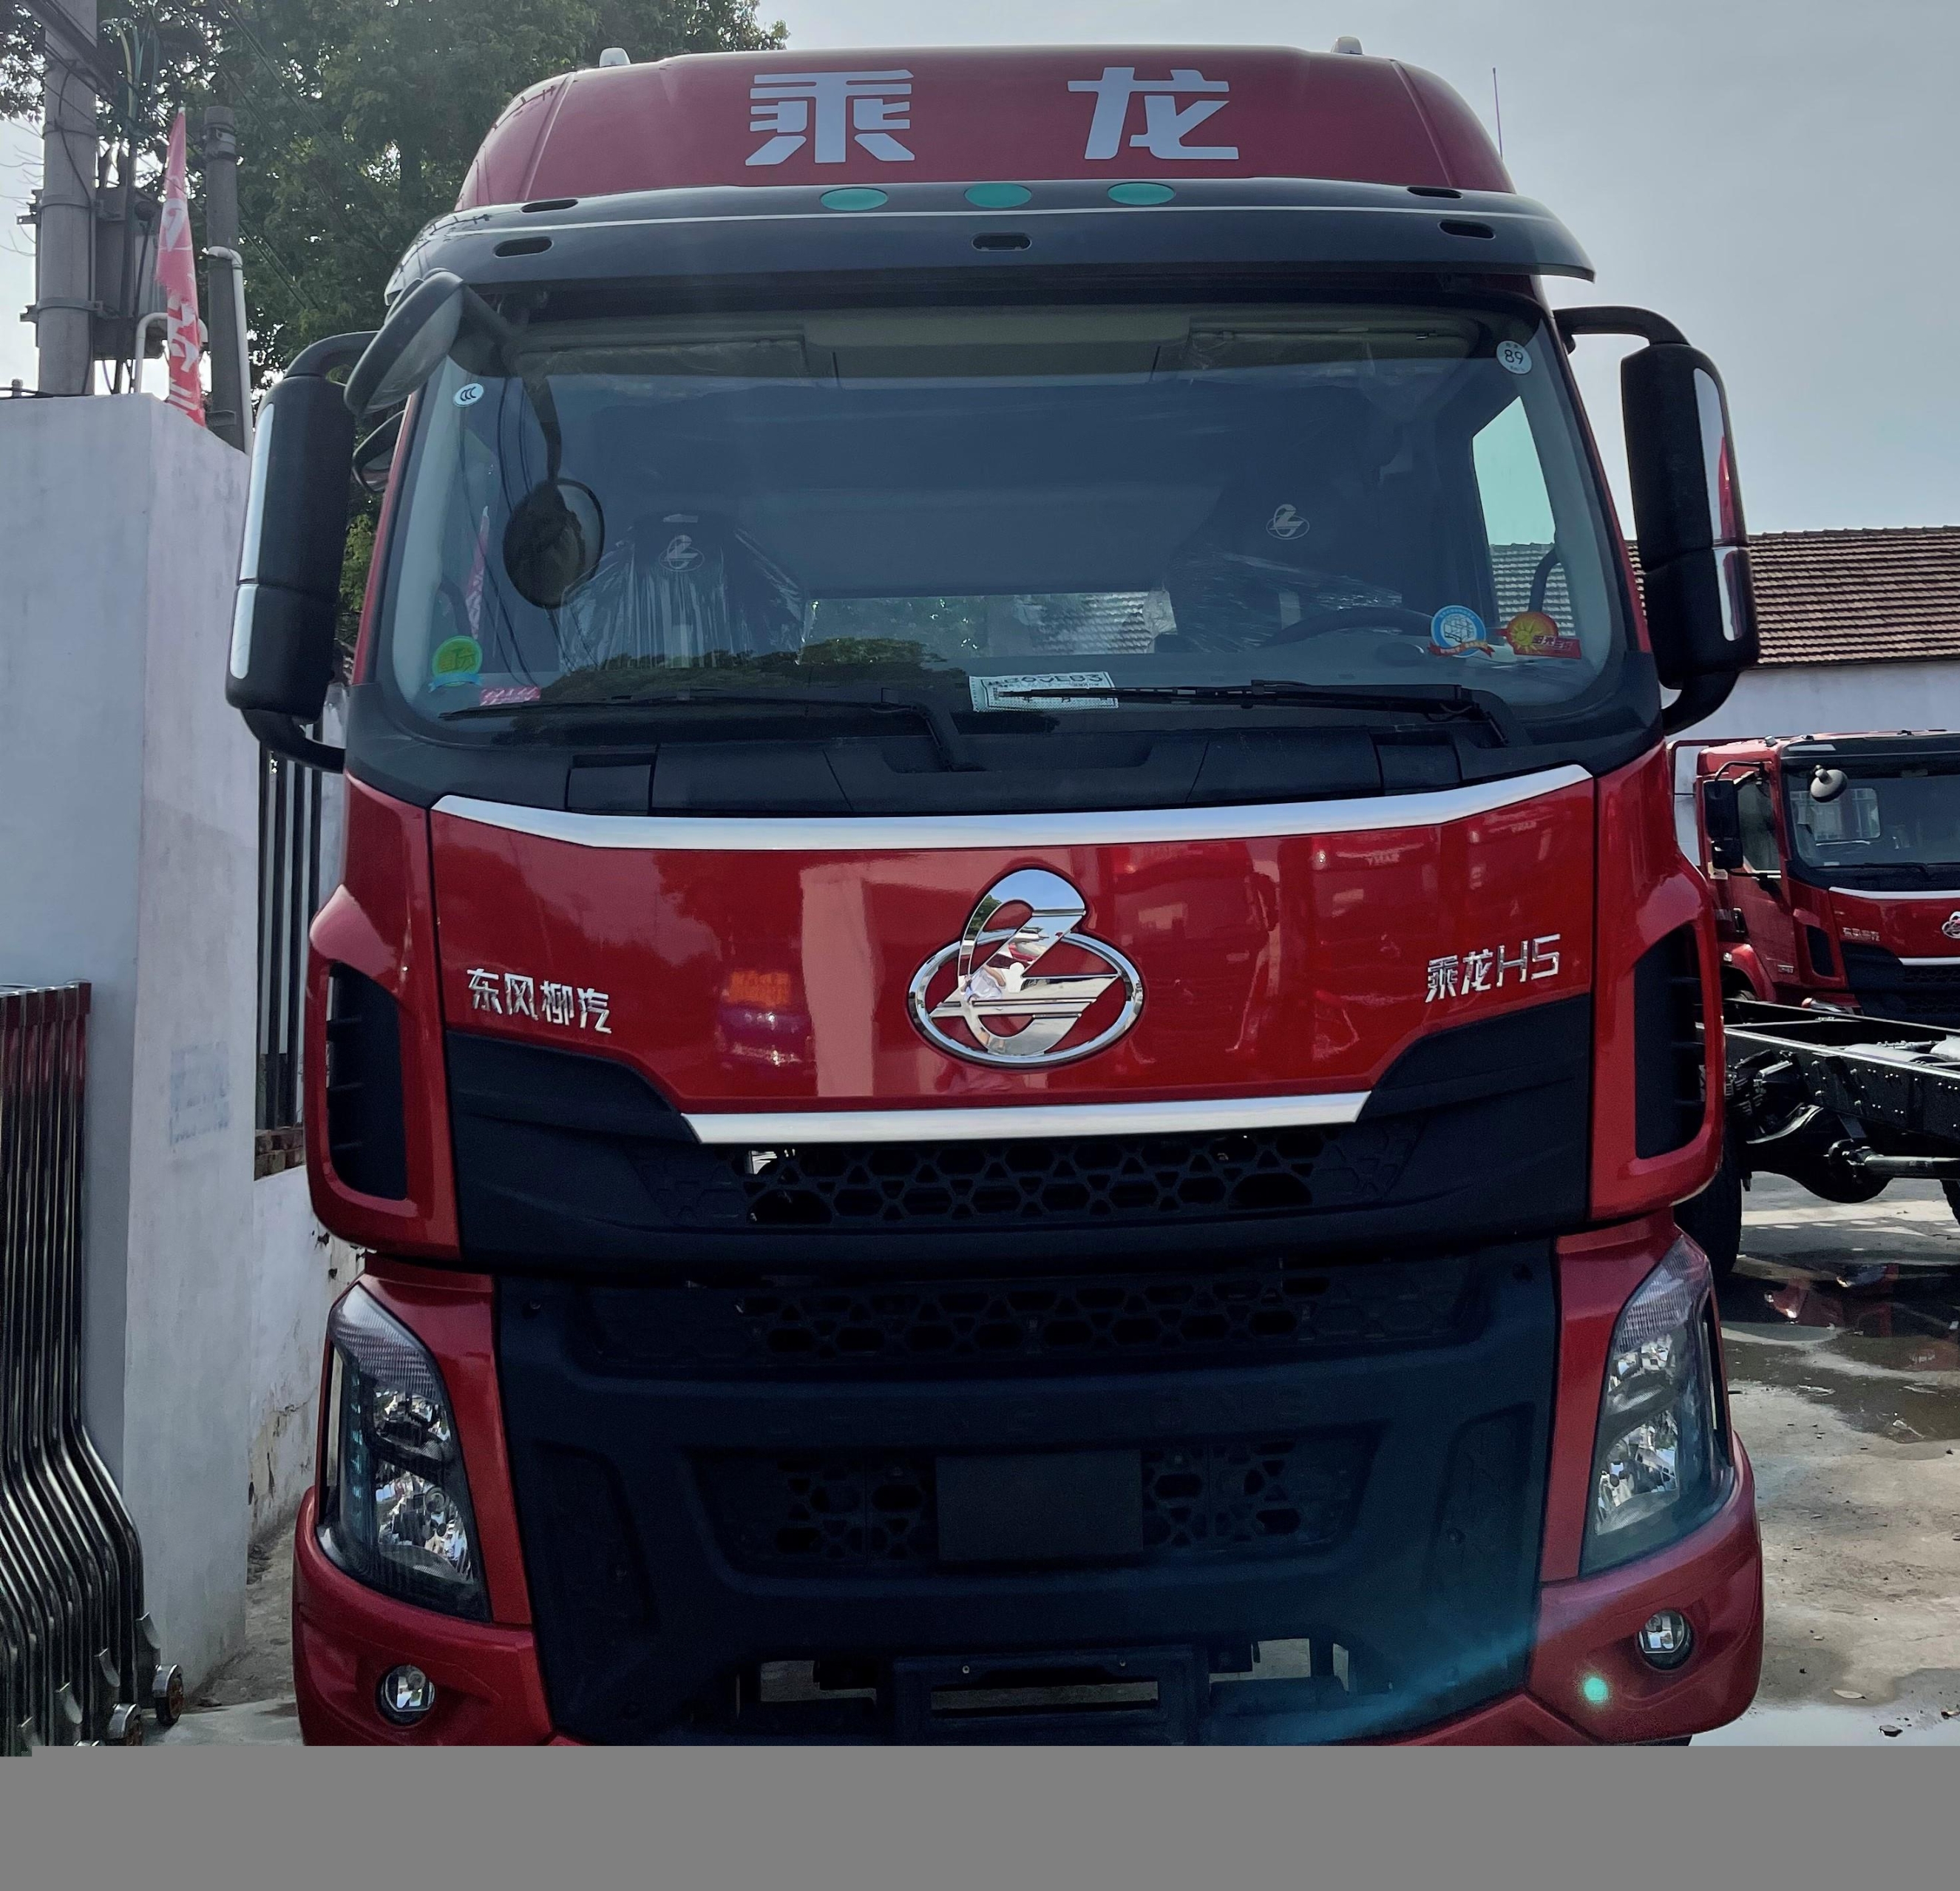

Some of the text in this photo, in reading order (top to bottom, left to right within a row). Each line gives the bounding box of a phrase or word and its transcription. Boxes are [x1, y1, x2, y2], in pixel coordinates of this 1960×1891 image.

[745, 67, 1239, 166] 乘龙
[1505, 349, 1524, 365] 89
[466, 967, 612, 1034] 东风柳汽
[1425, 933, 1561, 1003] 乘龙H5
